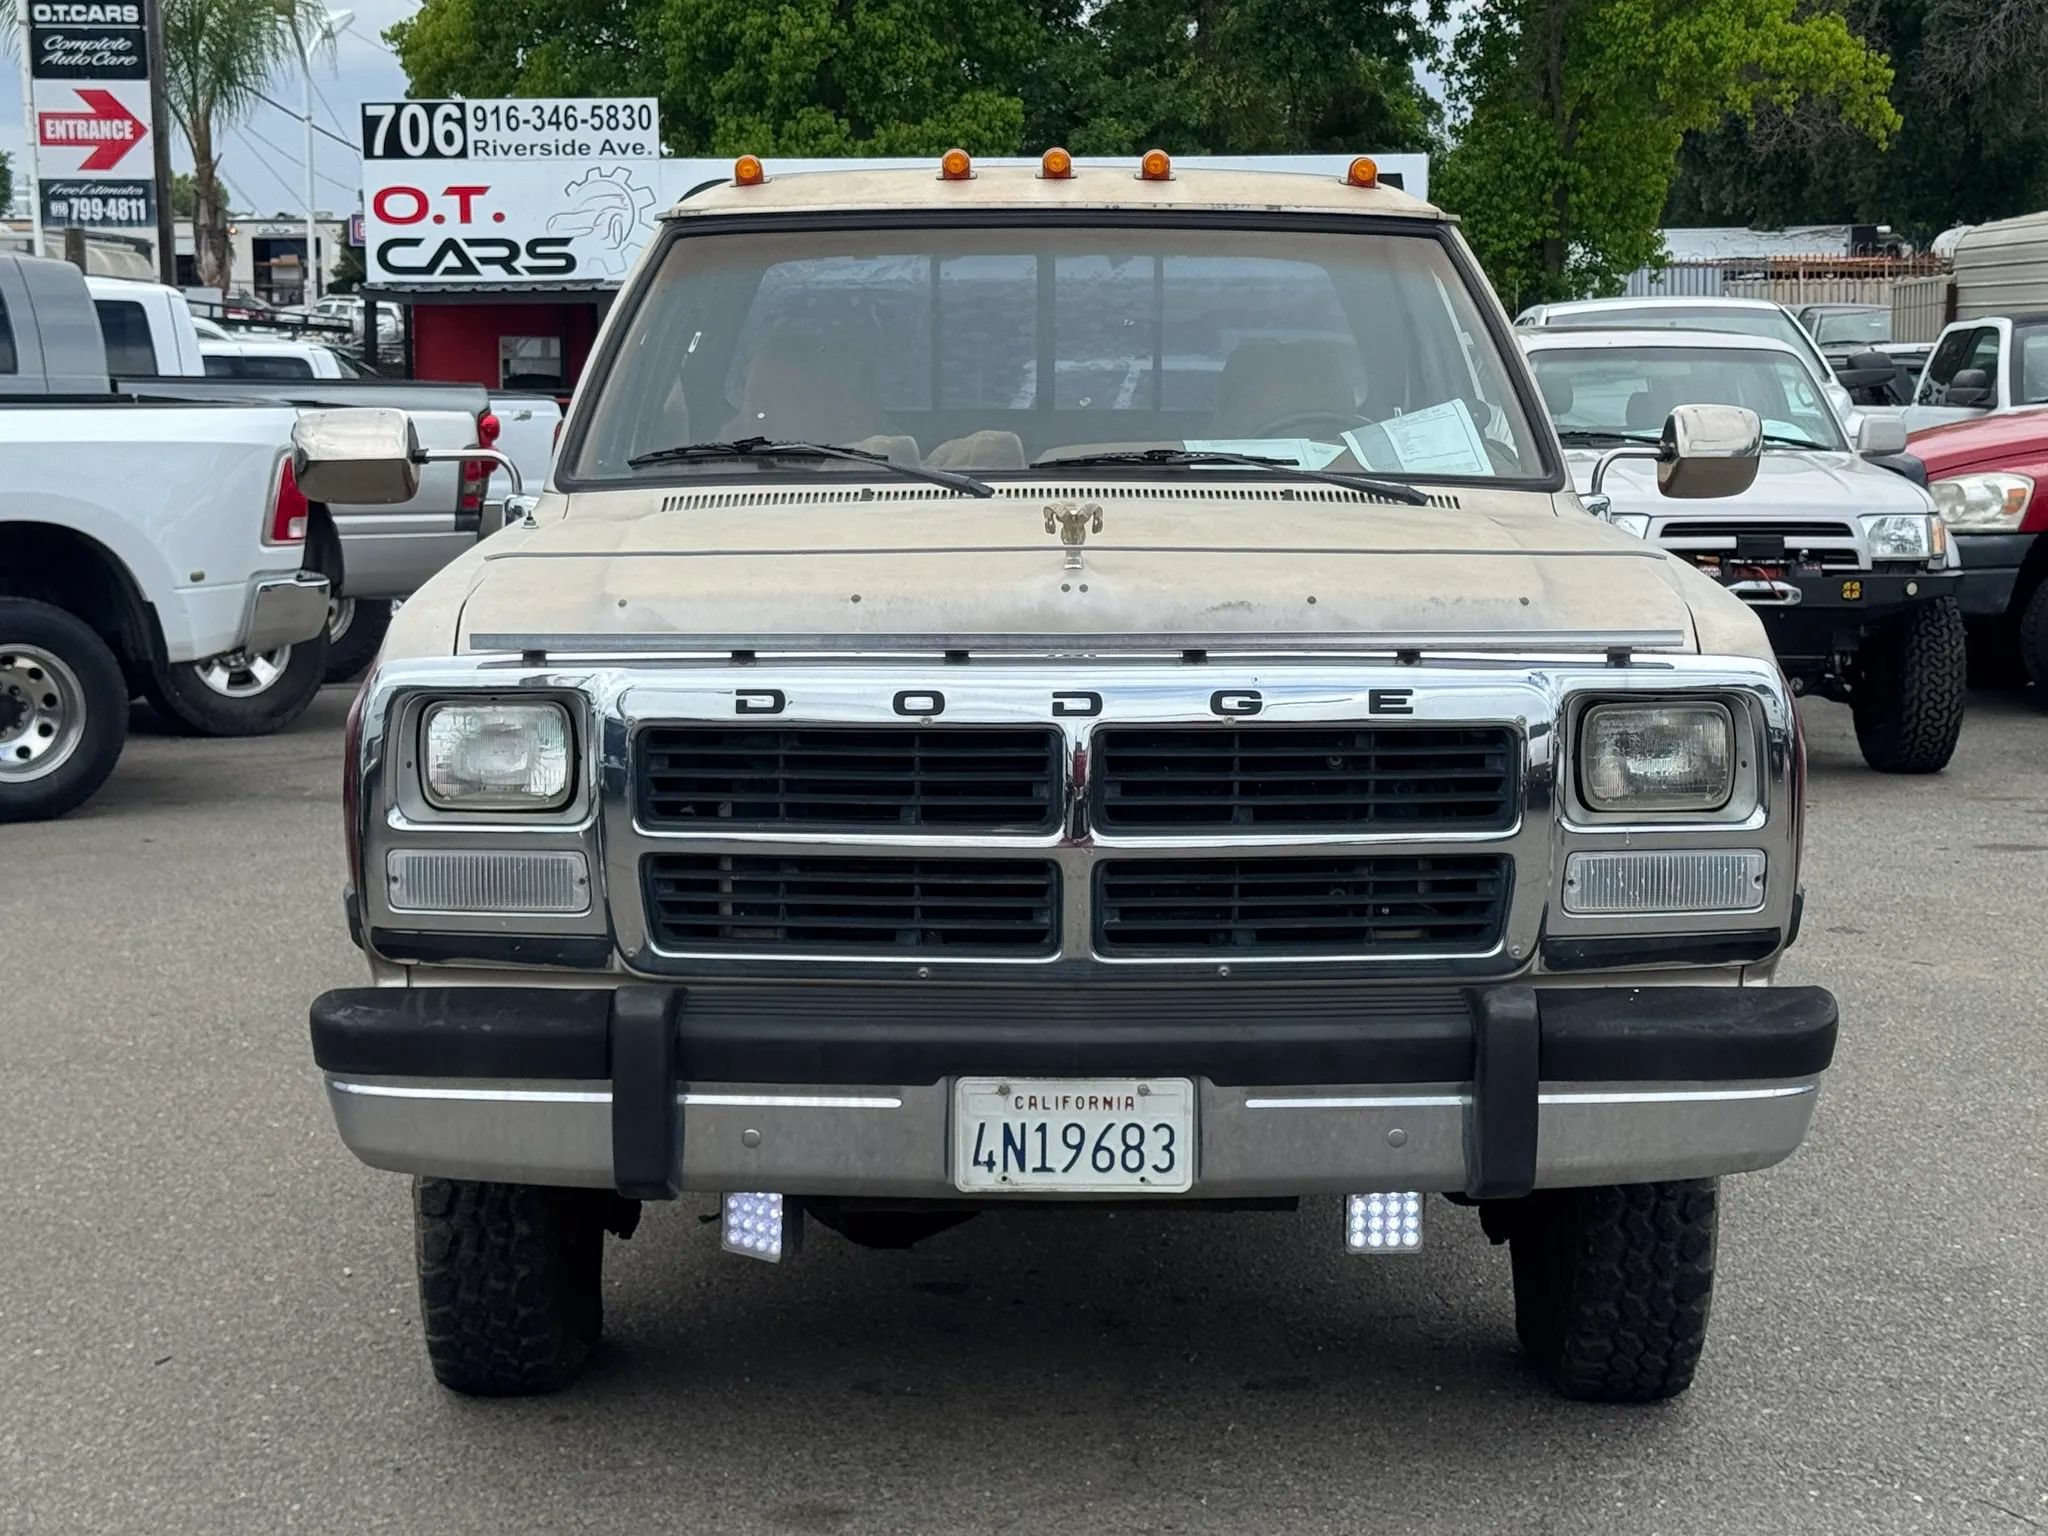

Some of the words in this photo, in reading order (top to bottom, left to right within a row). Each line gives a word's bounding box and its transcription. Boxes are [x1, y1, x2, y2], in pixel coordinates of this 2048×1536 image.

[44, 34, 133, 52] Complete
[41, 50, 91, 66] Auto
[91, 51, 138, 66] Care
[45, 119, 134, 140] ENTRANCE
[473, 104, 652, 132] 916-346-5830
[365, 104, 465, 157] 706
[474, 139, 591, 157] Riverside
[600, 139, 653, 156] Ave.
[48, 183, 80, 195] Free
[79, 183, 144, 195] Estimates
[69, 197, 147, 221] 799-4811
[373, 185, 506, 225] O.T.
[376, 237, 578, 276] CARS
[736, 689, 1413, 716] DODGE
[1014, 1095, 1135, 1111] CALIFORNIA
[972, 1122, 1176, 1174] 4N19683
